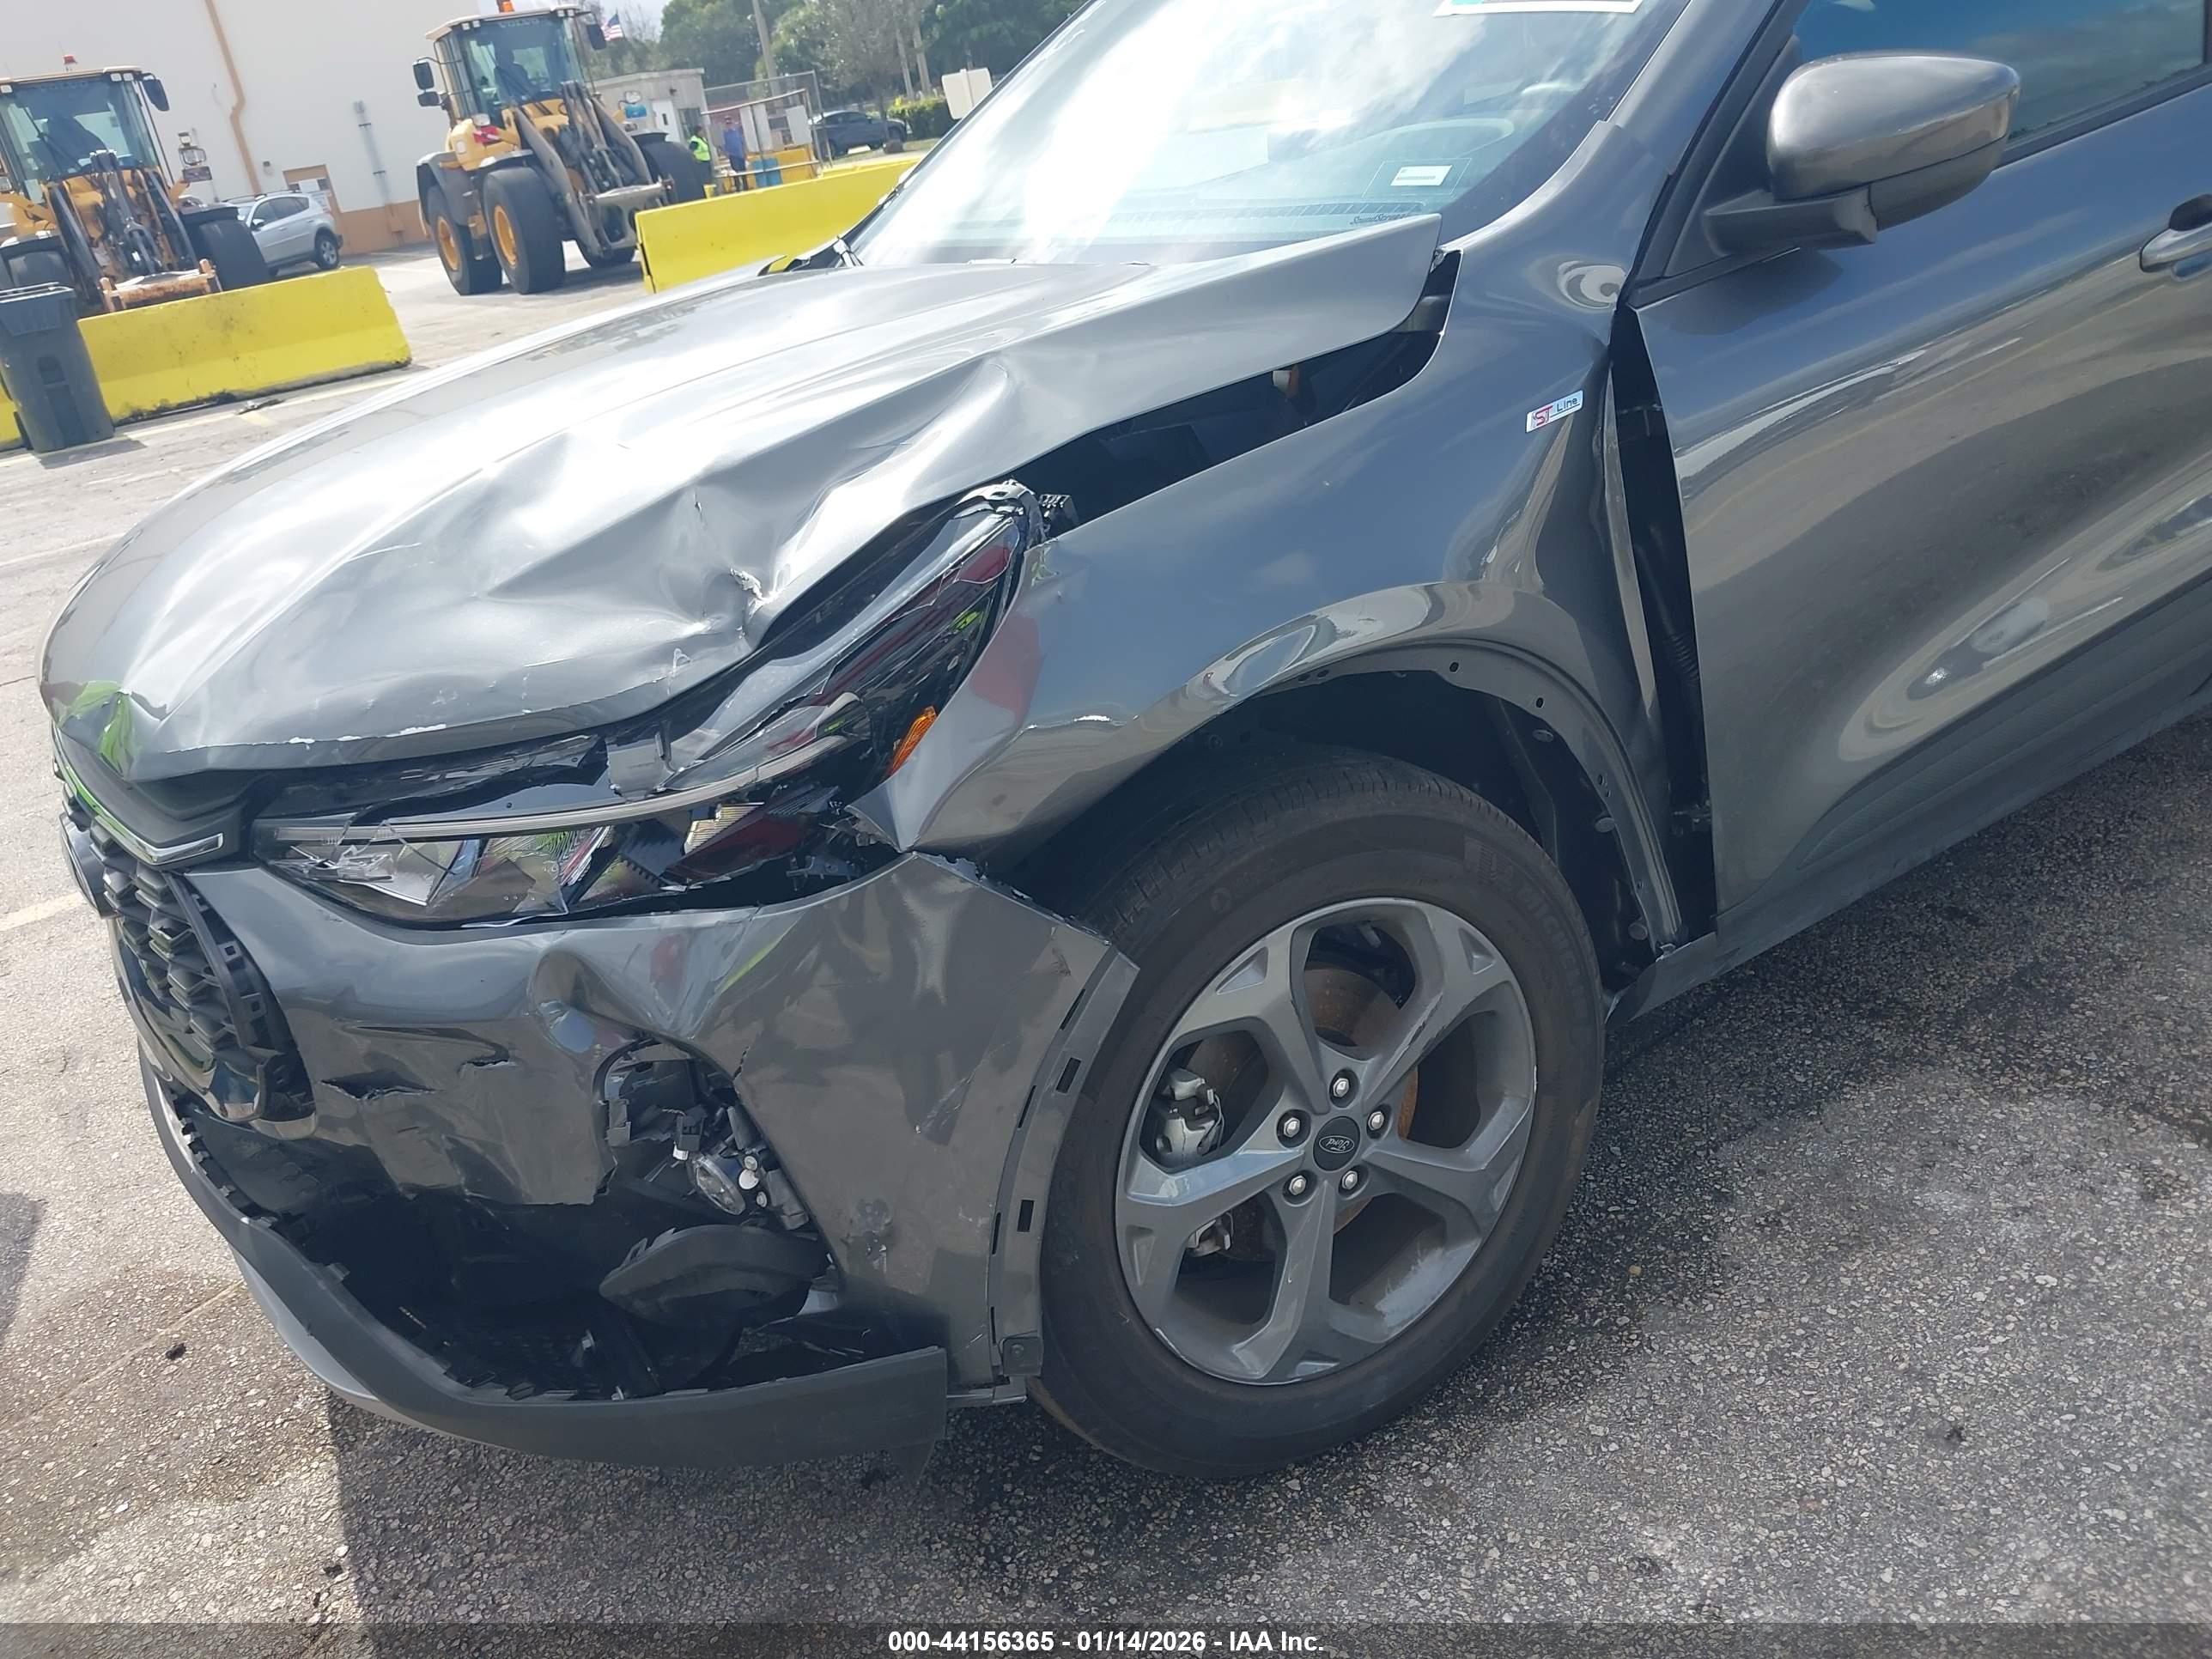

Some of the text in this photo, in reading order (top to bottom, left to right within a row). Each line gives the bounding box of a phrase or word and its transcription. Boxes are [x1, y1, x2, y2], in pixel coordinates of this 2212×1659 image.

[1533, 398, 1578, 427] ST Line
[1324, 1137, 1352, 1152] Ford
